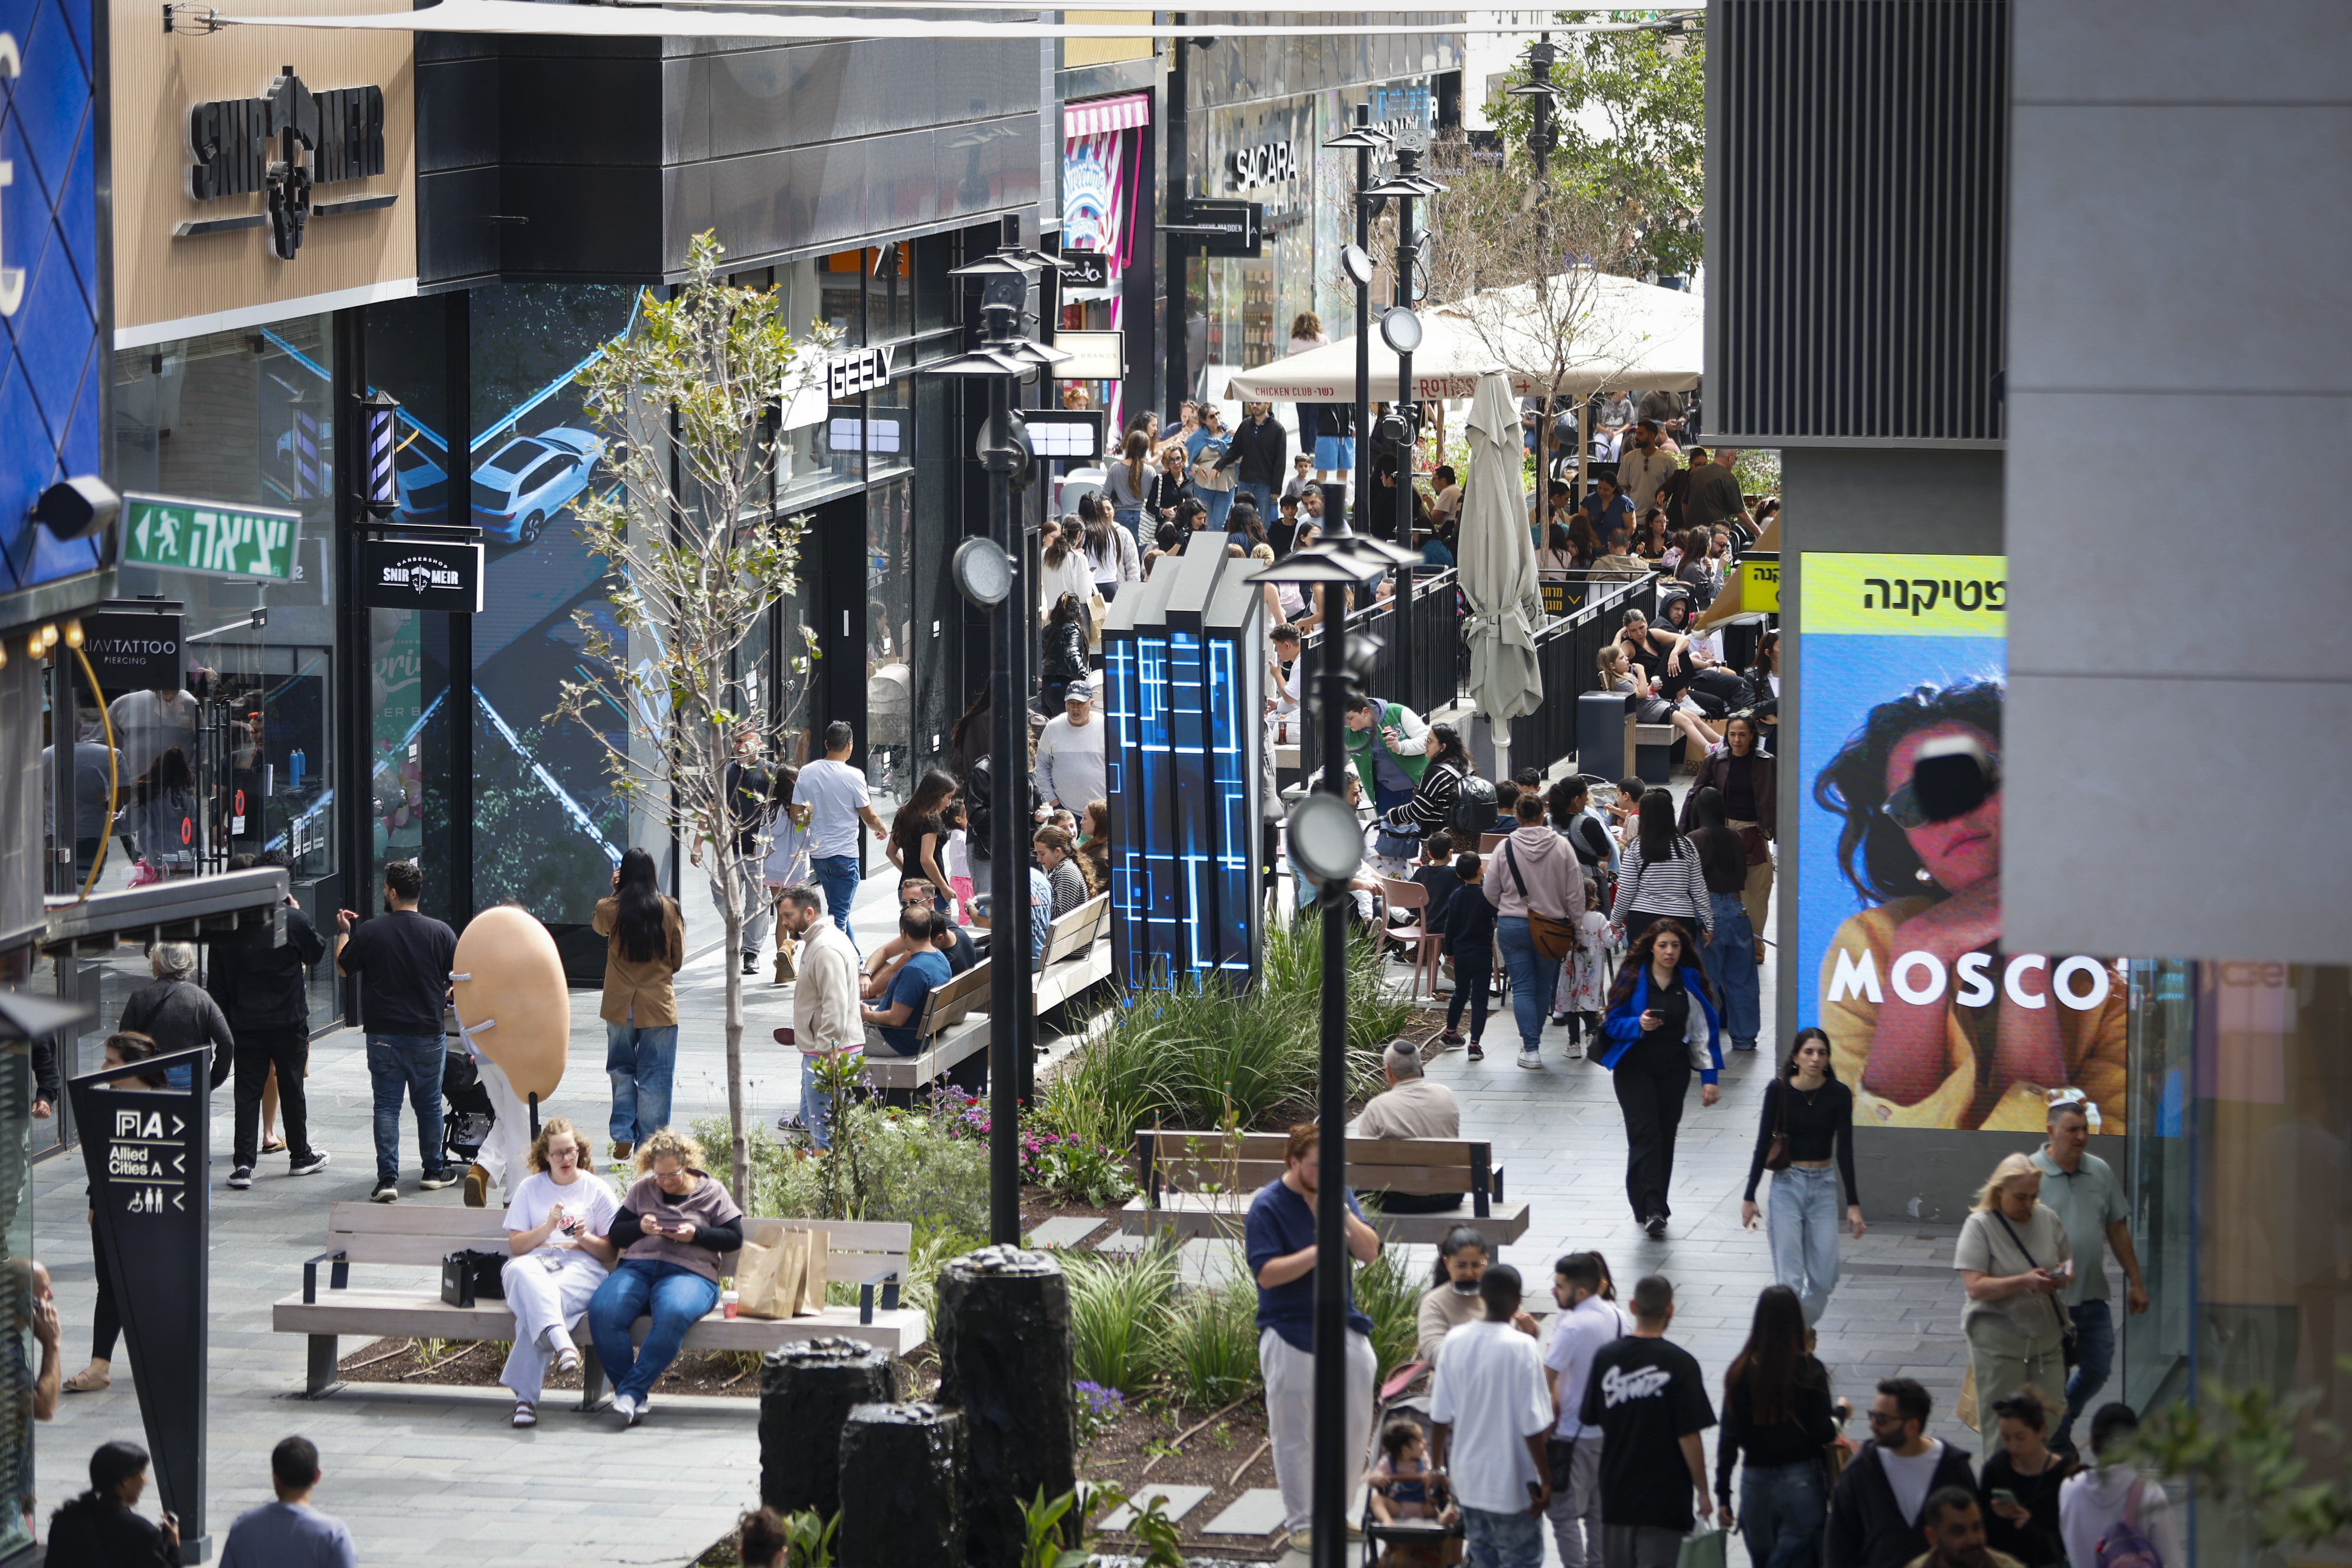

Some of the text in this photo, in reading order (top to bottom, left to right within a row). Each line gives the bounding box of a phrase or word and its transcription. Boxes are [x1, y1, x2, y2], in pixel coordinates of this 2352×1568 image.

[191, 85, 385, 201] SNIR MEIR
[1236, 141, 1298, 193] SACARA
[831, 345, 895, 400] GEELY
[1255, 387, 1289, 397] CHICKEN
[1292, 387, 1312, 396] CLUB
[188, 511, 289, 577] יציאה
[396, 557, 448, 569] BARBERSHOP
[383, 567, 459, 585] SNIR MEIR
[1545, 600, 1563, 612] מוגן
[104, 656, 147, 665] PIERCING
[1827, 948, 2126, 1011] MOSCO
[109, 1145, 149, 1162] Allied
[109, 1160, 163, 1177] Cities A
